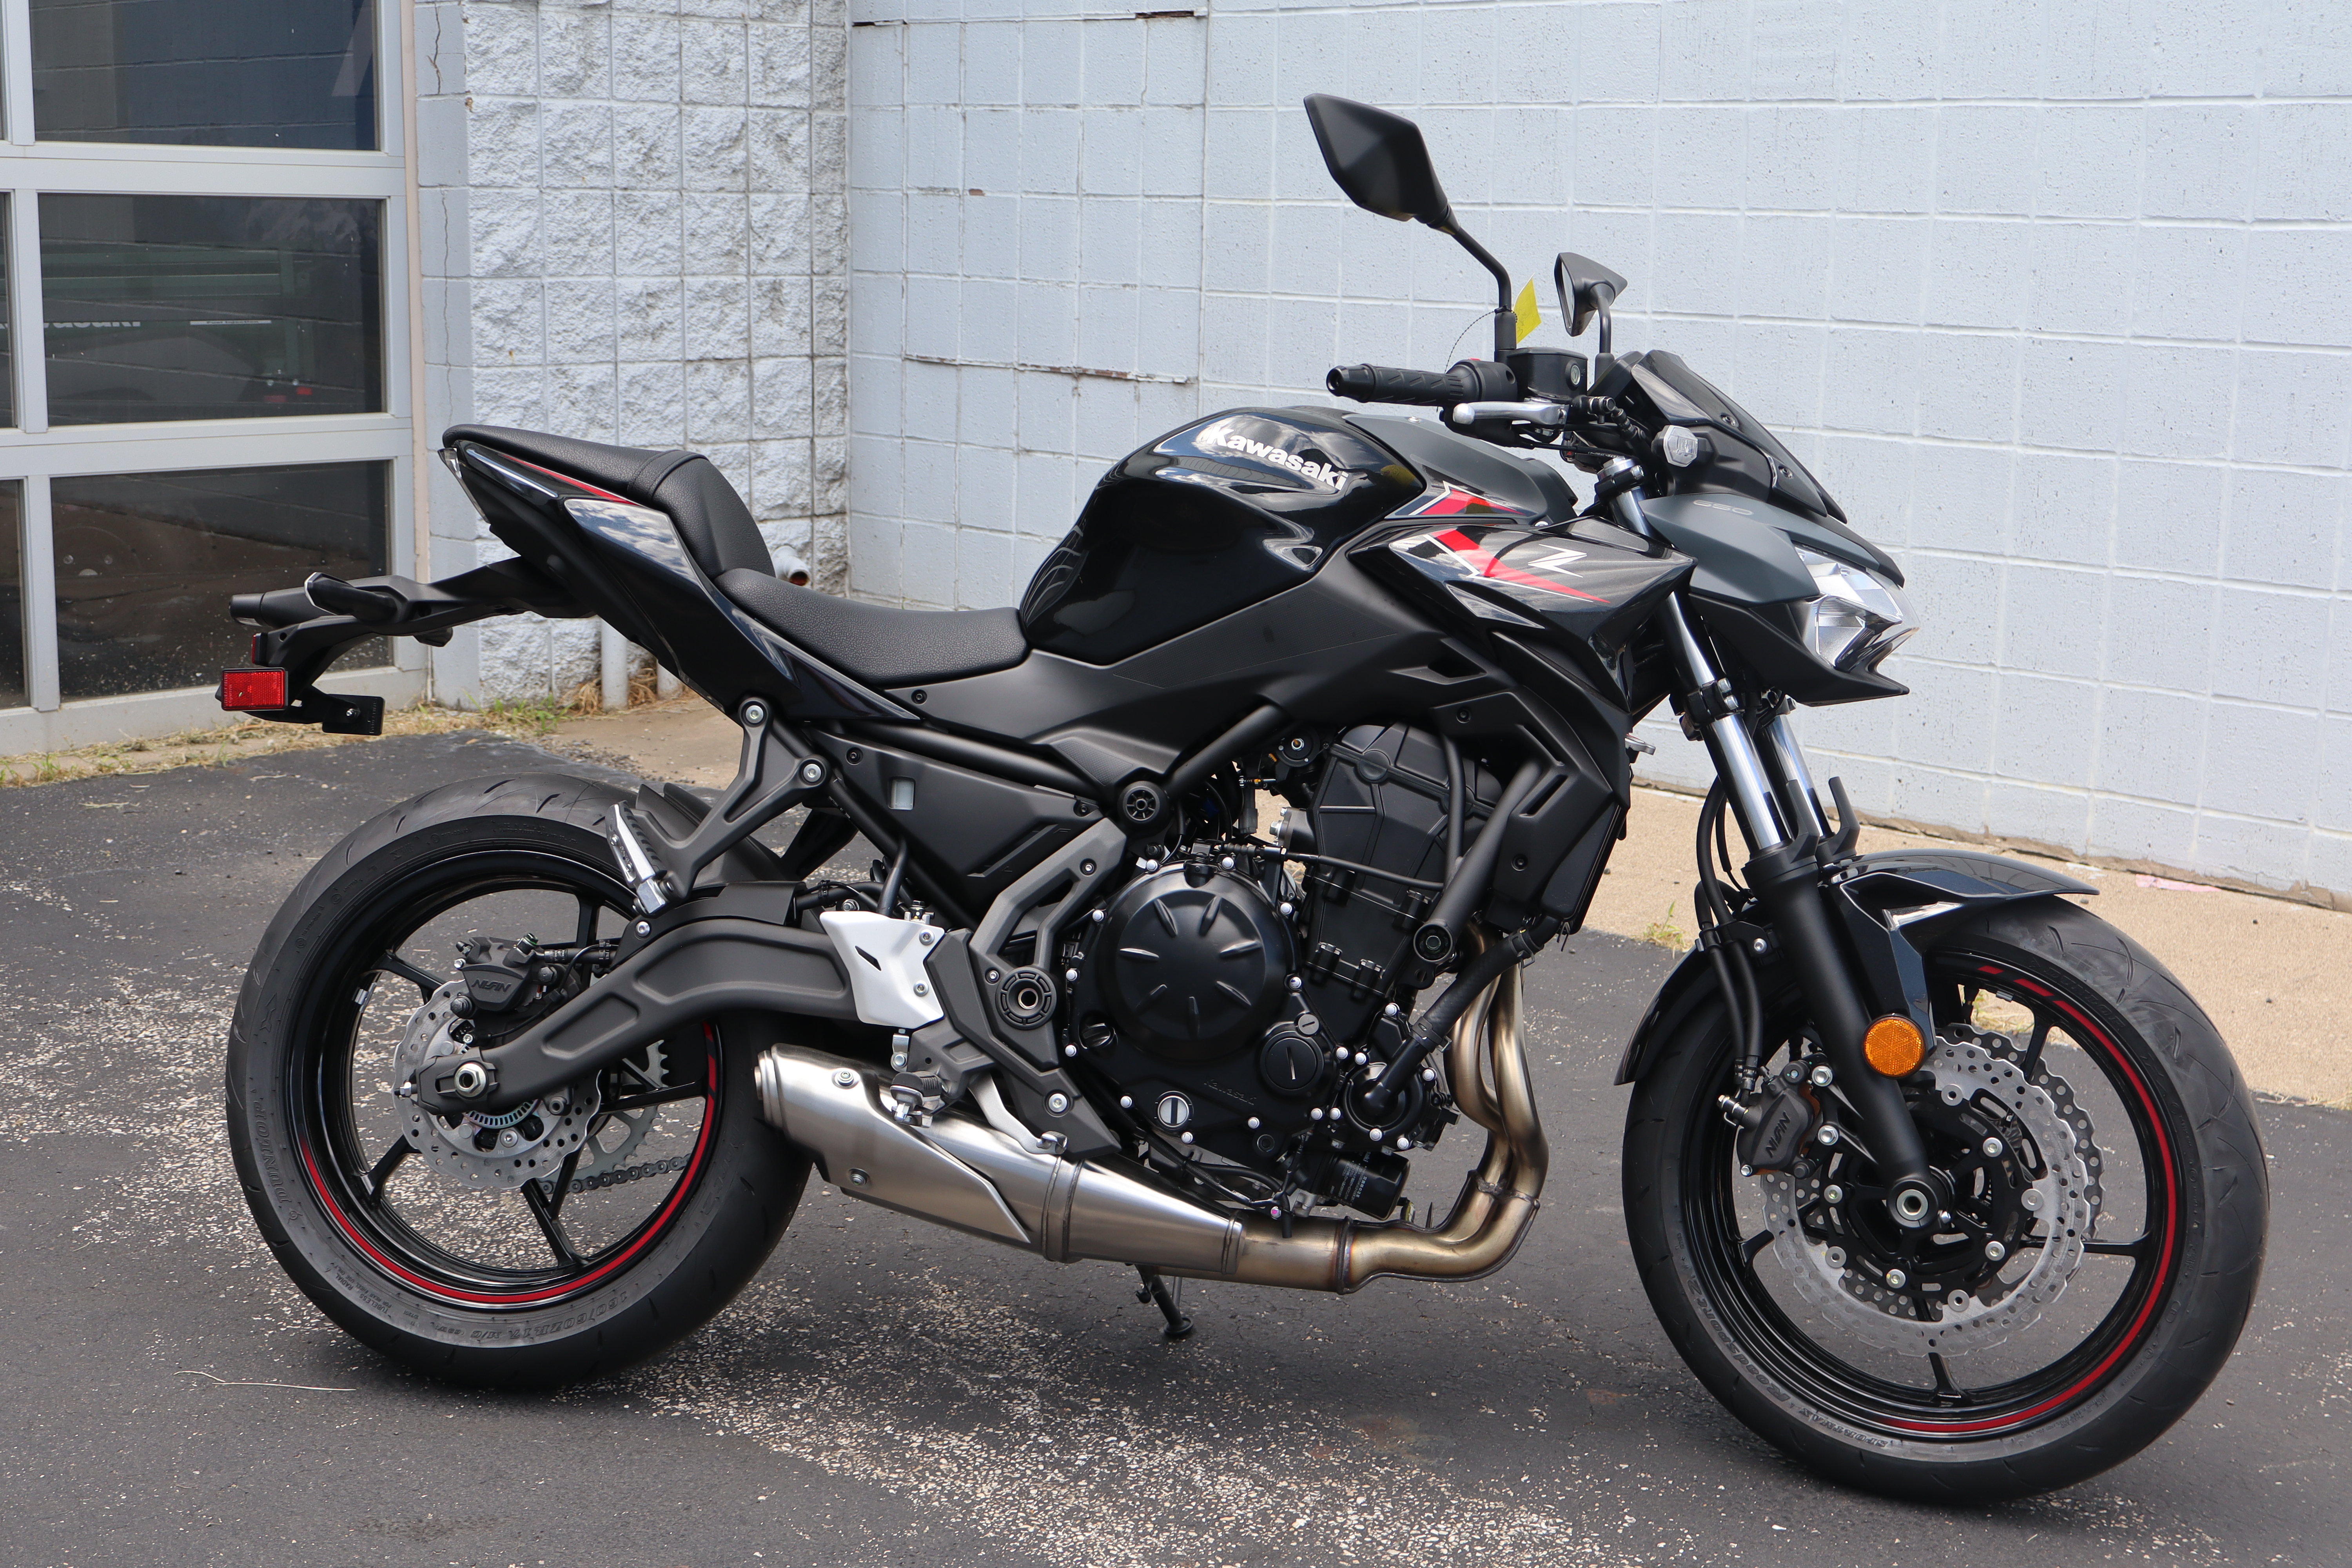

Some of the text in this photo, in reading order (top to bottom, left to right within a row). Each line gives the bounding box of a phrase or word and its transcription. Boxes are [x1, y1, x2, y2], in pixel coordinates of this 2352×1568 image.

[1207, 426, 1349, 491] Kawasaki
[1693, 500, 1754, 515] 650
[253, 1101, 292, 1203] DUNLOP
[334, 1272, 388, 1314] TUBELESS RADIAL
[345, 1274, 355, 1284] USE
[369, 1292, 381, 1303] REAR
[382, 1300, 392, 1308] FOR
[470, 1329, 501, 1341] M/C
[1695, 1296, 1791, 1404] Roadsport
[1798, 1406, 1888, 1448] SPORTMAX
